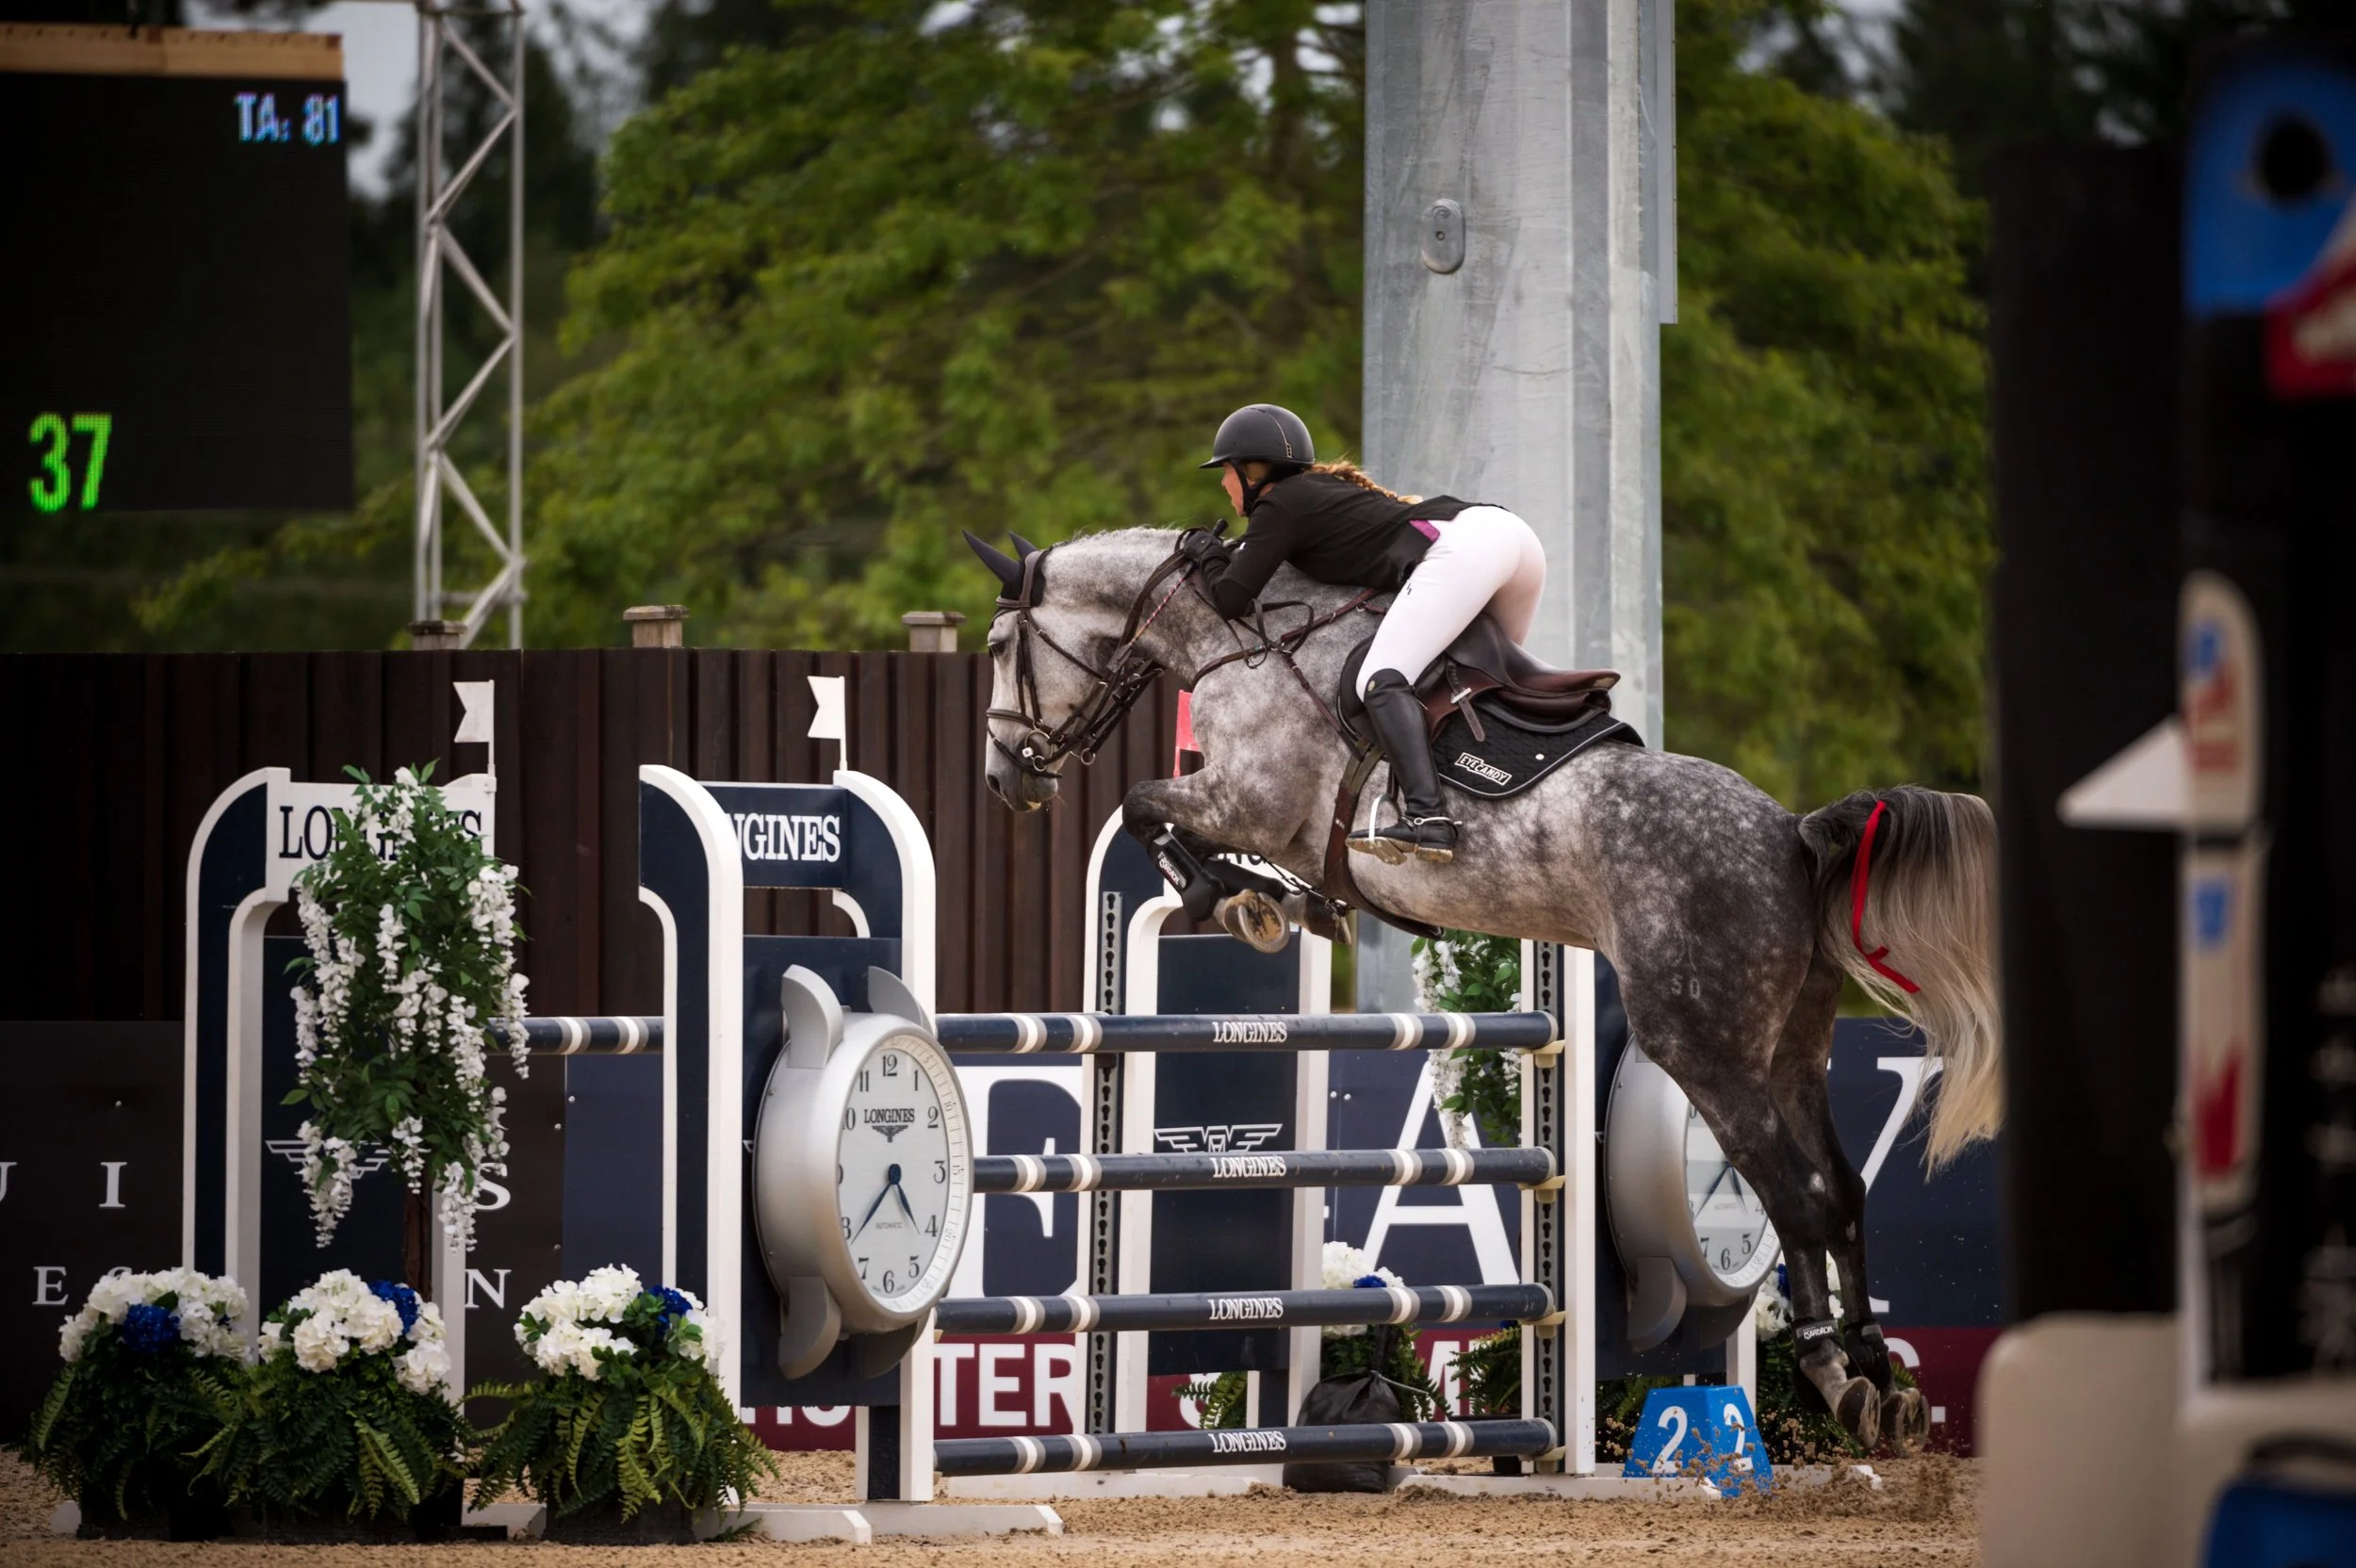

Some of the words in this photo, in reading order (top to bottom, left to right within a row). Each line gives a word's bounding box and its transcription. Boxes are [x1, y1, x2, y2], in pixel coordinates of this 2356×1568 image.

[303, 93, 340, 148] 81
[28, 411, 112, 514] 37
[1212, 1021, 1287, 1043] LONGINES
[882, 1054, 898, 1077] 12
[859, 1070, 870, 1092] 11
[913, 1070, 919, 1091] 1
[863, 1107, 915, 1123] LONGINES
[927, 1106, 939, 1129] 2
[934, 1160, 946, 1184] 3
[1210, 1156, 1287, 1178] LONGINES
[924, 1215, 939, 1237] 4
[1700, 1236, 1710, 1259] 7
[1742, 1233, 1752, 1255] 5
[859, 1257, 870, 1280] 7
[908, 1255, 921, 1279] 5
[1721, 1248, 1731, 1270] 6
[882, 1269, 895, 1294] 6
[1208, 1298, 1284, 1320] LONGINES
[1208, 1430, 1287, 1453] LONGINES
[1652, 1405, 1688, 1474] 2
[1723, 1403, 1754, 1472] 2
